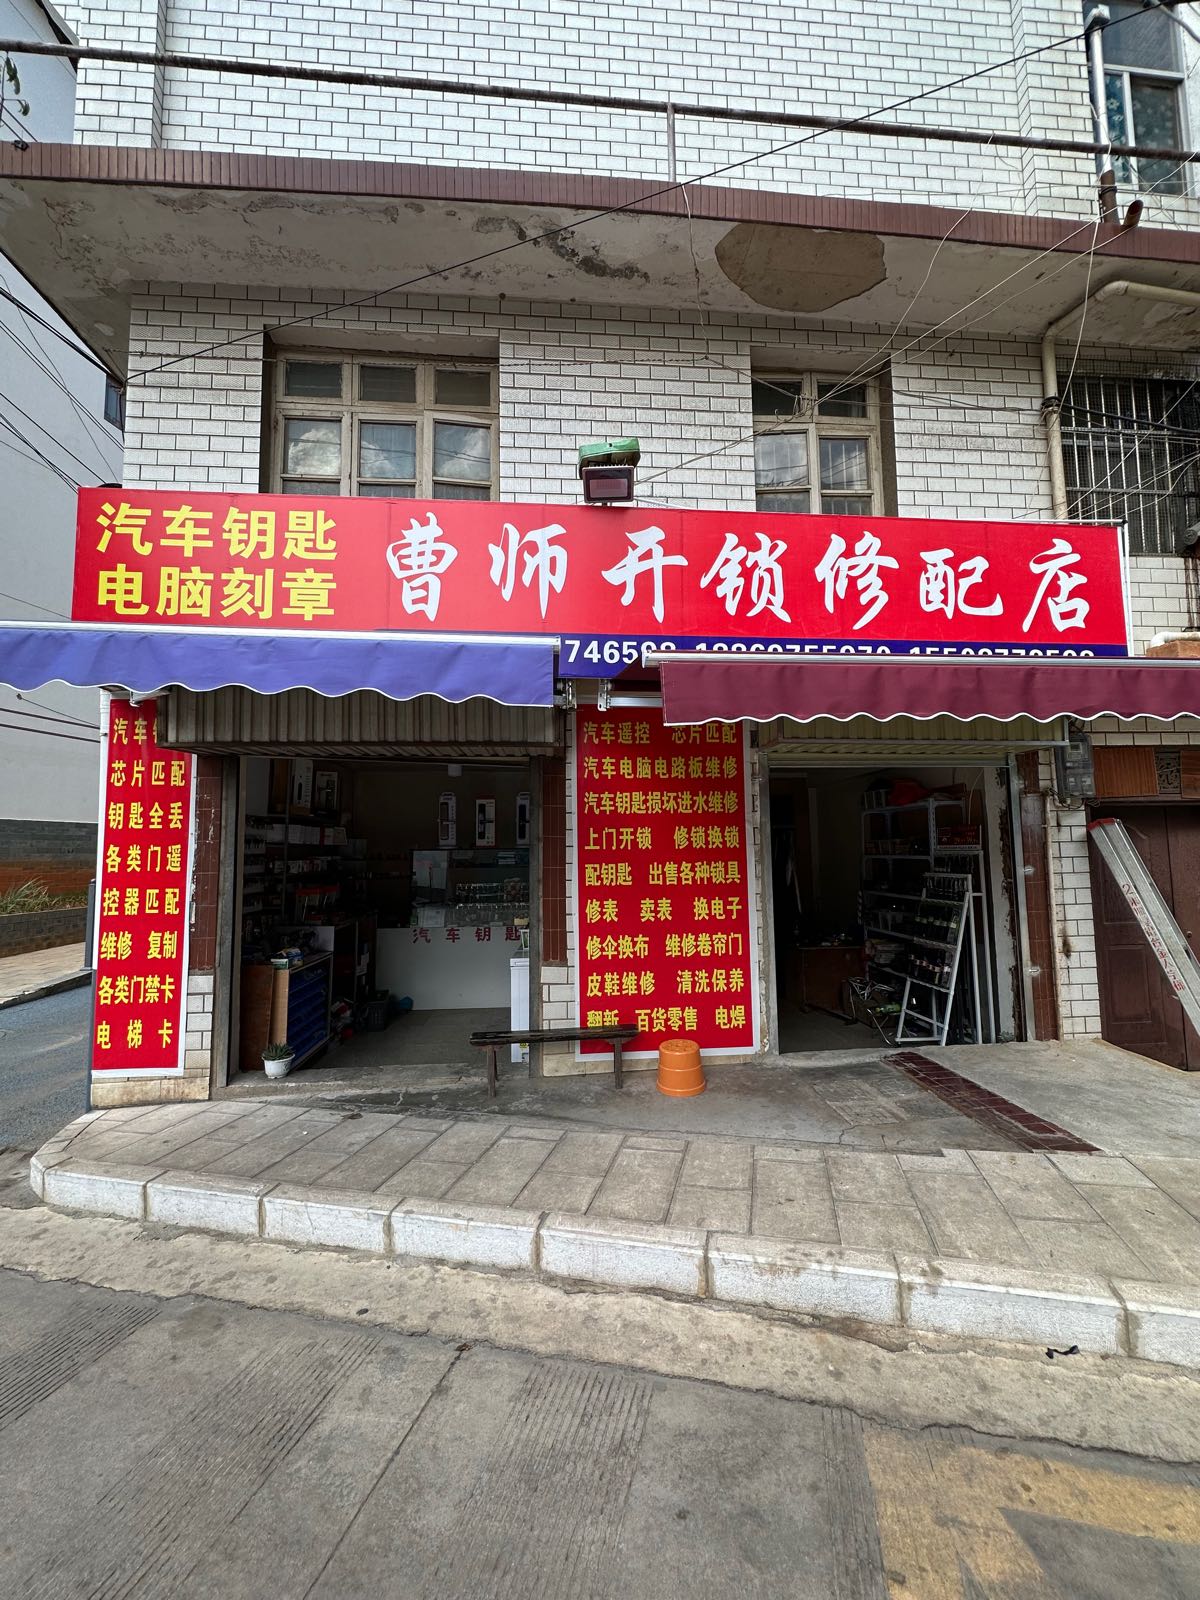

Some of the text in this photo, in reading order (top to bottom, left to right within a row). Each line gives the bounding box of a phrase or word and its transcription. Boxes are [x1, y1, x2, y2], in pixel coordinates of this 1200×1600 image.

[96, 501, 338, 560] 汽车钥匙
[386, 511, 1092, 633] 曹师开锁修配店
[96, 563, 338, 621] 电脑刻章
[113, 718, 157, 744] 汽车
[584, 722, 650, 744] 汽车遥控
[111, 760, 185, 787] 芯片匹配
[584, 757, 737, 779] 汽车电脑电路板维修
[108, 802, 183, 830] 钥匙全丢
[584, 791, 738, 814] 汽车钥匙损坏进水维修
[585, 826, 739, 850] 上门开锁 修锁换锁
[106, 844, 181, 873] 各类门遥
[585, 861, 740, 886] 配钥匙 出售各种锁具
[103, 888, 179, 916] 控器匹配
[586, 896, 742, 923] 修表 卖表 换电子
[100, 931, 177, 960] 维修 复制
[412, 927, 521, 944] 汽车钥匙
[586, 932, 743, 960] 修伞换布 维修卷帘门
[98, 975, 175, 1005] 各类门禁卡
[587, 968, 744, 997] 皮鞋维修 清洗保养
[634, 1006, 698, 1032] 百货零售
[716, 1005, 746, 1030] 电焊
